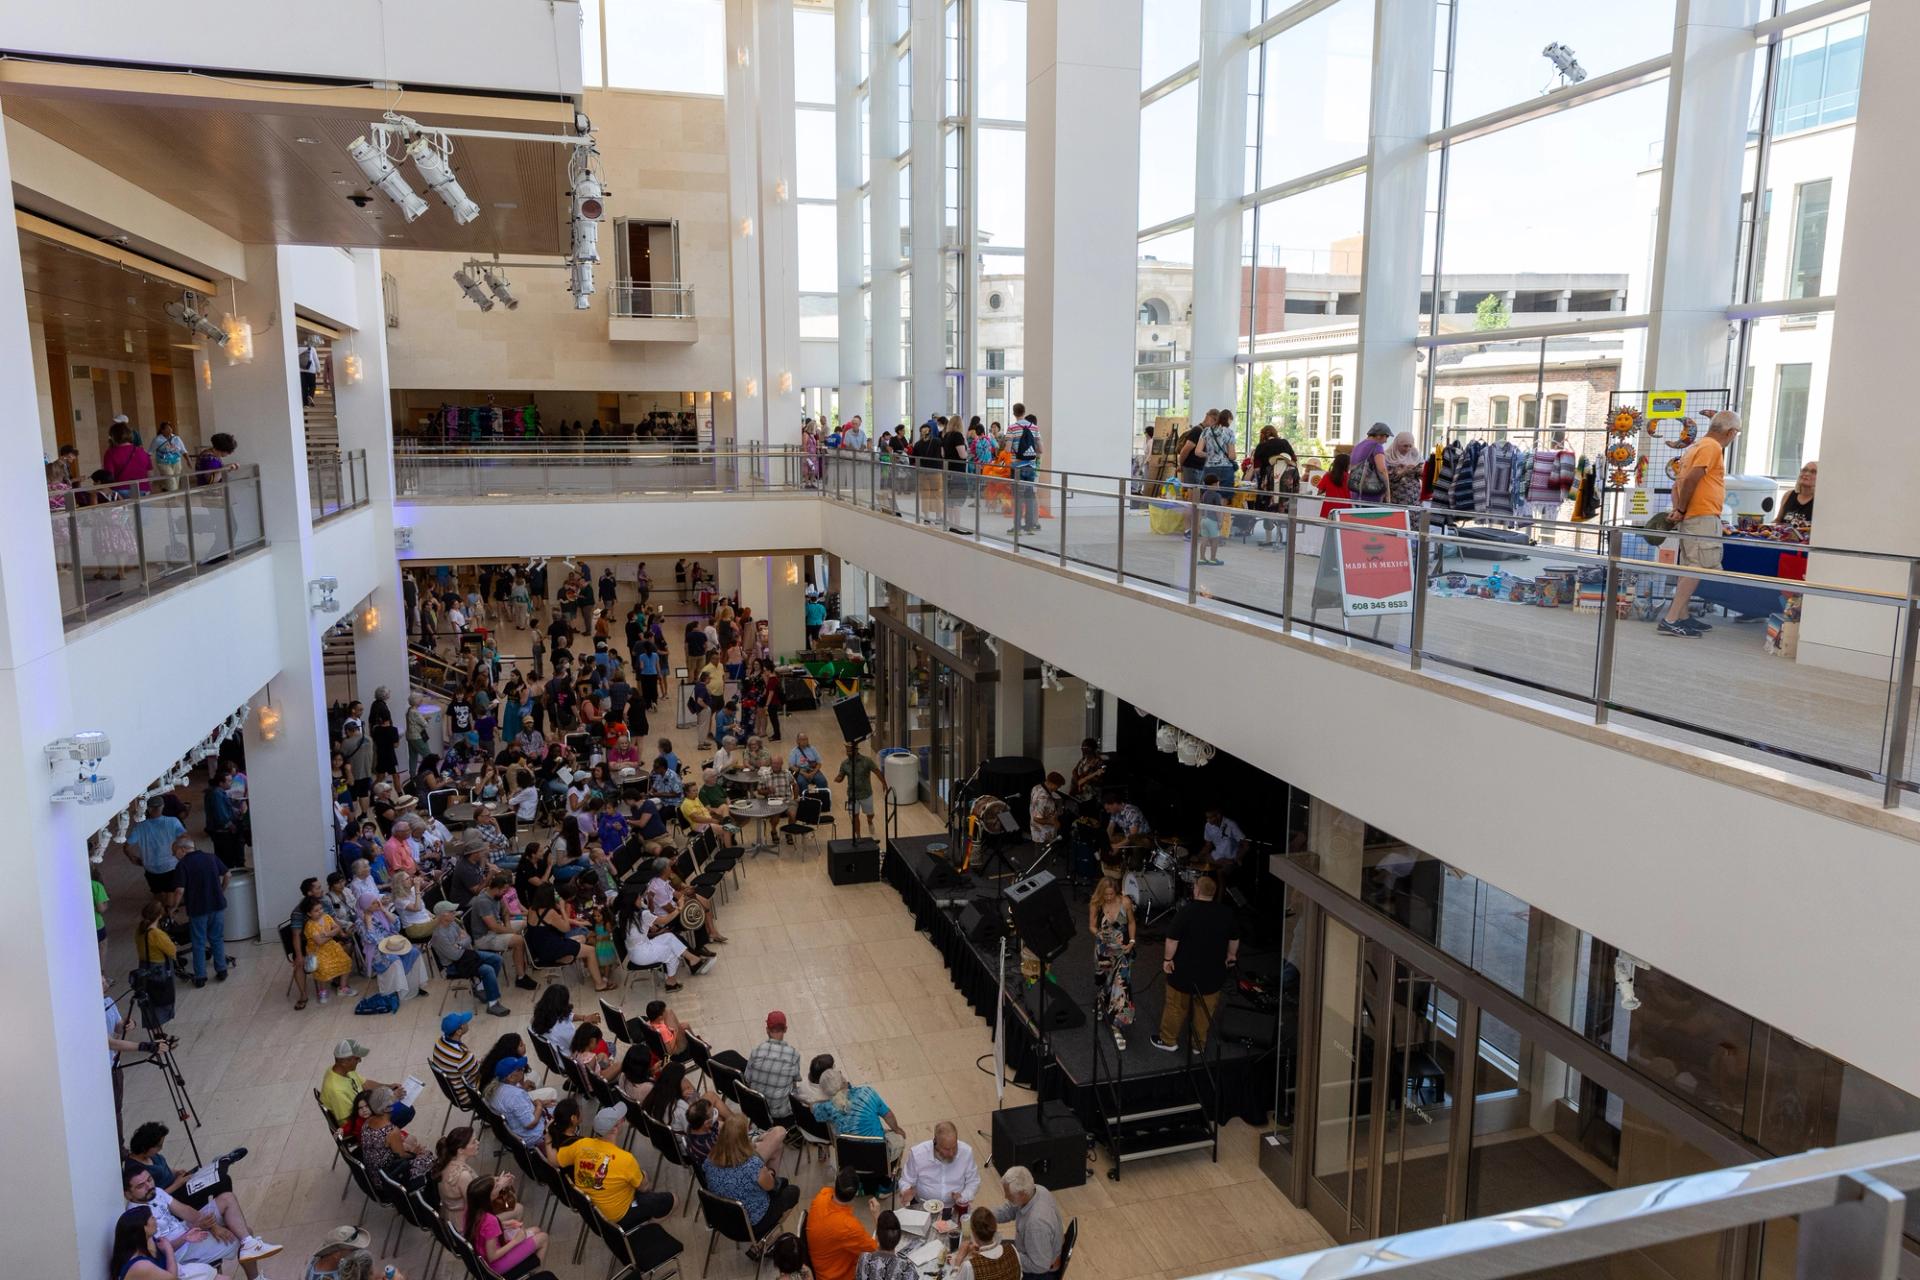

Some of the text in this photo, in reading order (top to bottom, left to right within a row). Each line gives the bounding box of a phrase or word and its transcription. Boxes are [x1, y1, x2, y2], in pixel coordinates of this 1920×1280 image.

[1380, 560, 1409, 568] MEXICO
[1352, 600, 1408, 610] 608 345 8533
